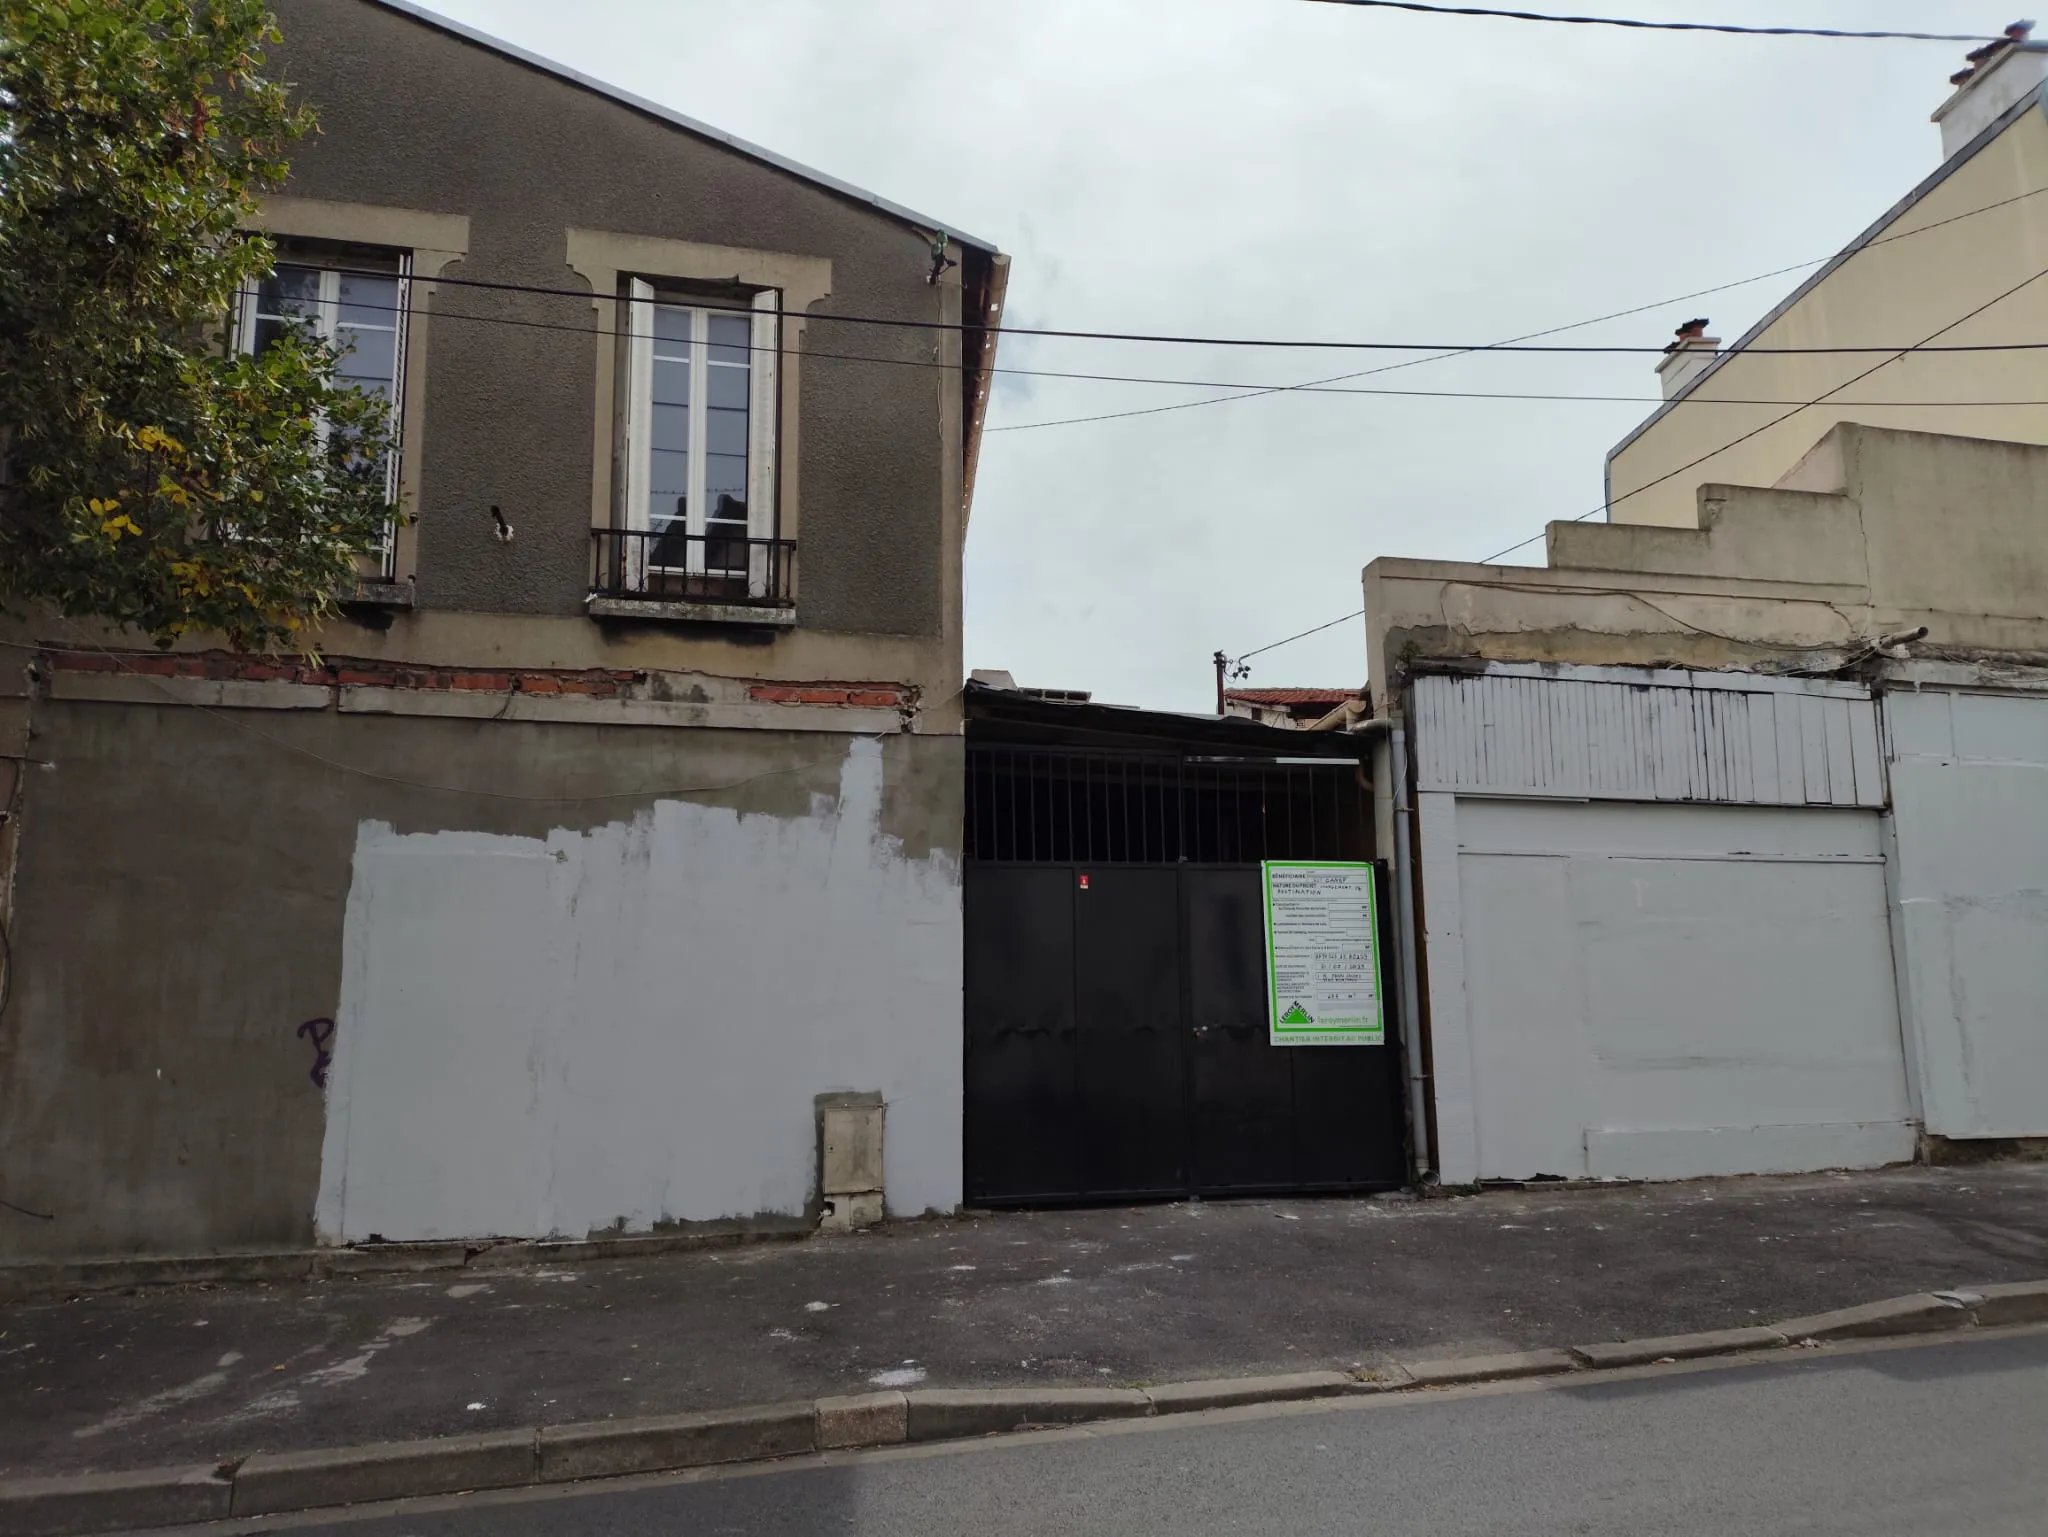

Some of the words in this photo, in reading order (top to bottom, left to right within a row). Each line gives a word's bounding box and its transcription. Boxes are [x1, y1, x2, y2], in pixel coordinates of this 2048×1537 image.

[1279, 1005, 1295, 1024] LEROY
[1293, 1000, 1315, 1024] MERLIN
[1316, 1015, 1368, 1025] leroymerlin.fr
[1273, 1035, 1311, 1043] CHANTIER
